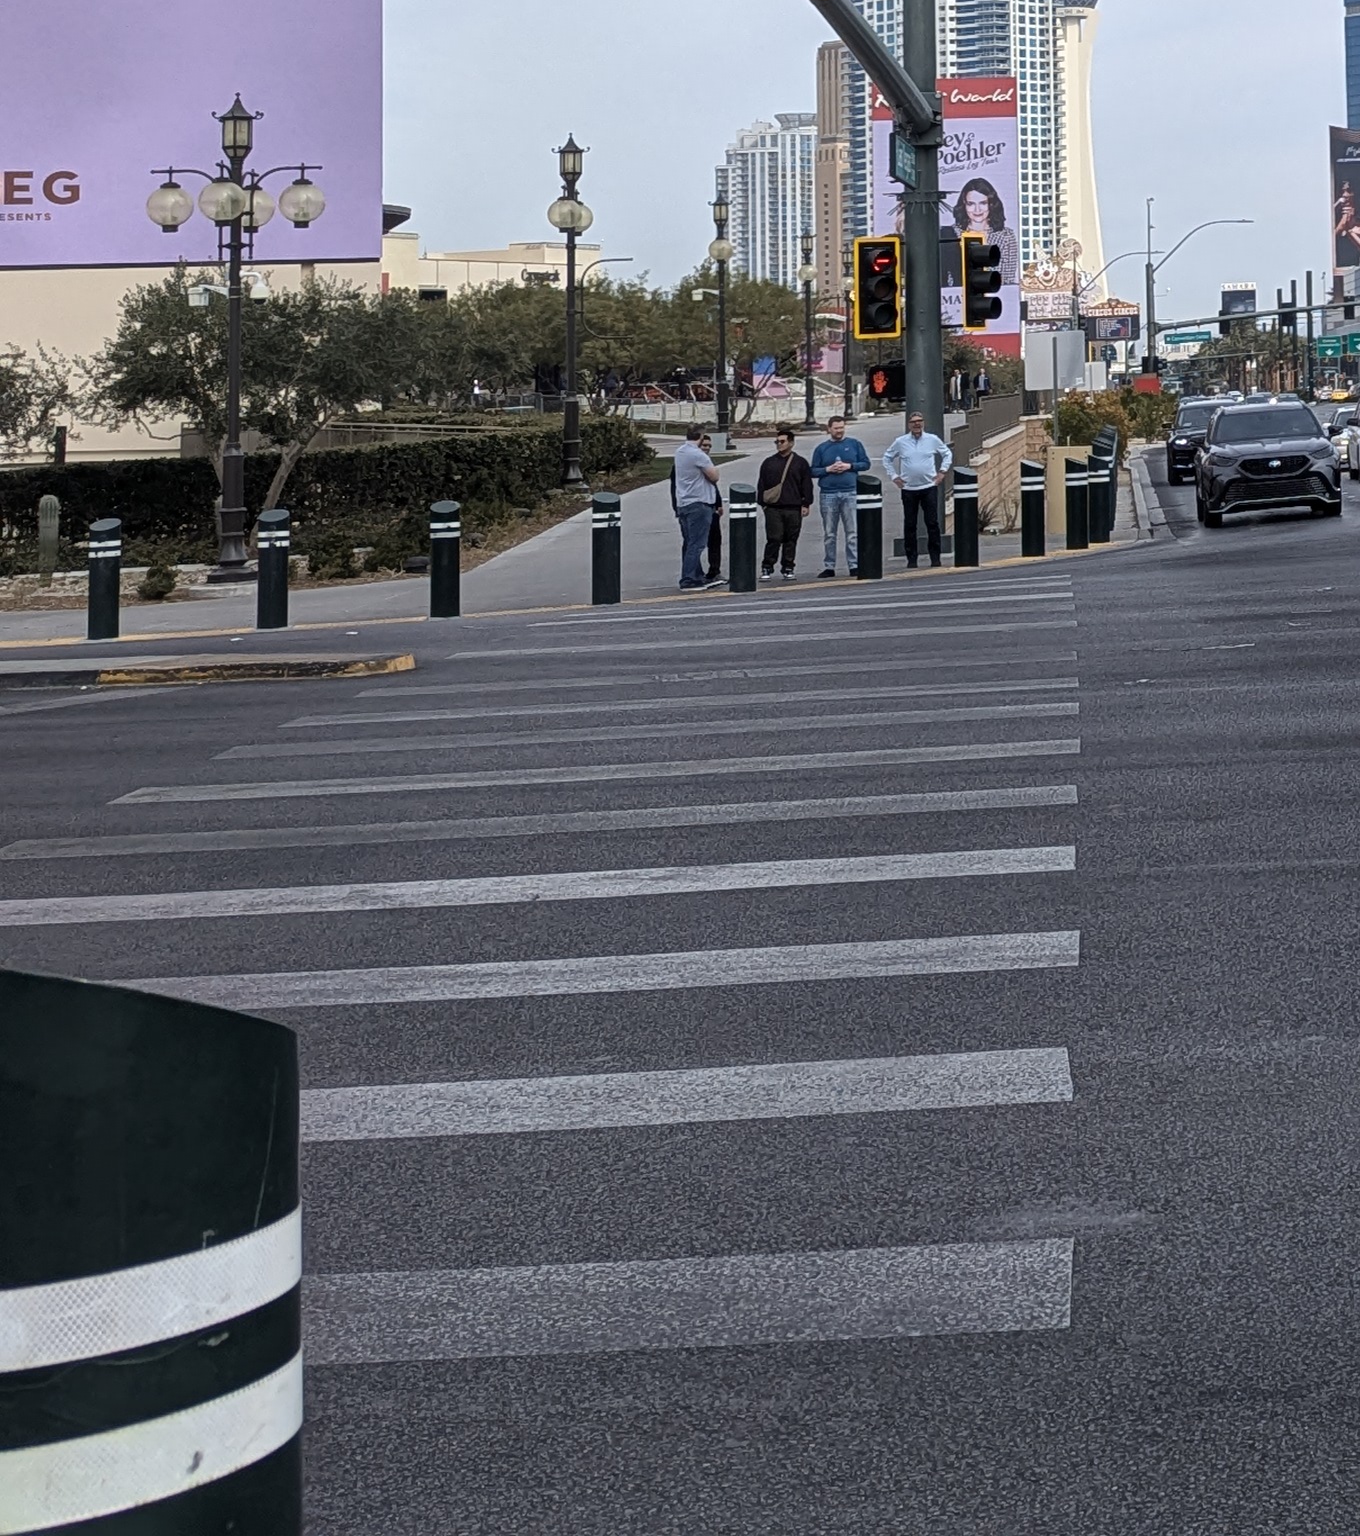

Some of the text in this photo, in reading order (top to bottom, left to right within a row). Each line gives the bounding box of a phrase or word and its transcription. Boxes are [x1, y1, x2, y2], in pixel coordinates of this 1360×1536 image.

[950, 87, 1015, 104] World
[3, 170, 81, 205] EG
[0, 212, 52, 222] ESENTS
[1221, 282, 1255, 290] SAHARA
[1087, 306, 1139, 317] CIRCUS CIRCUS
